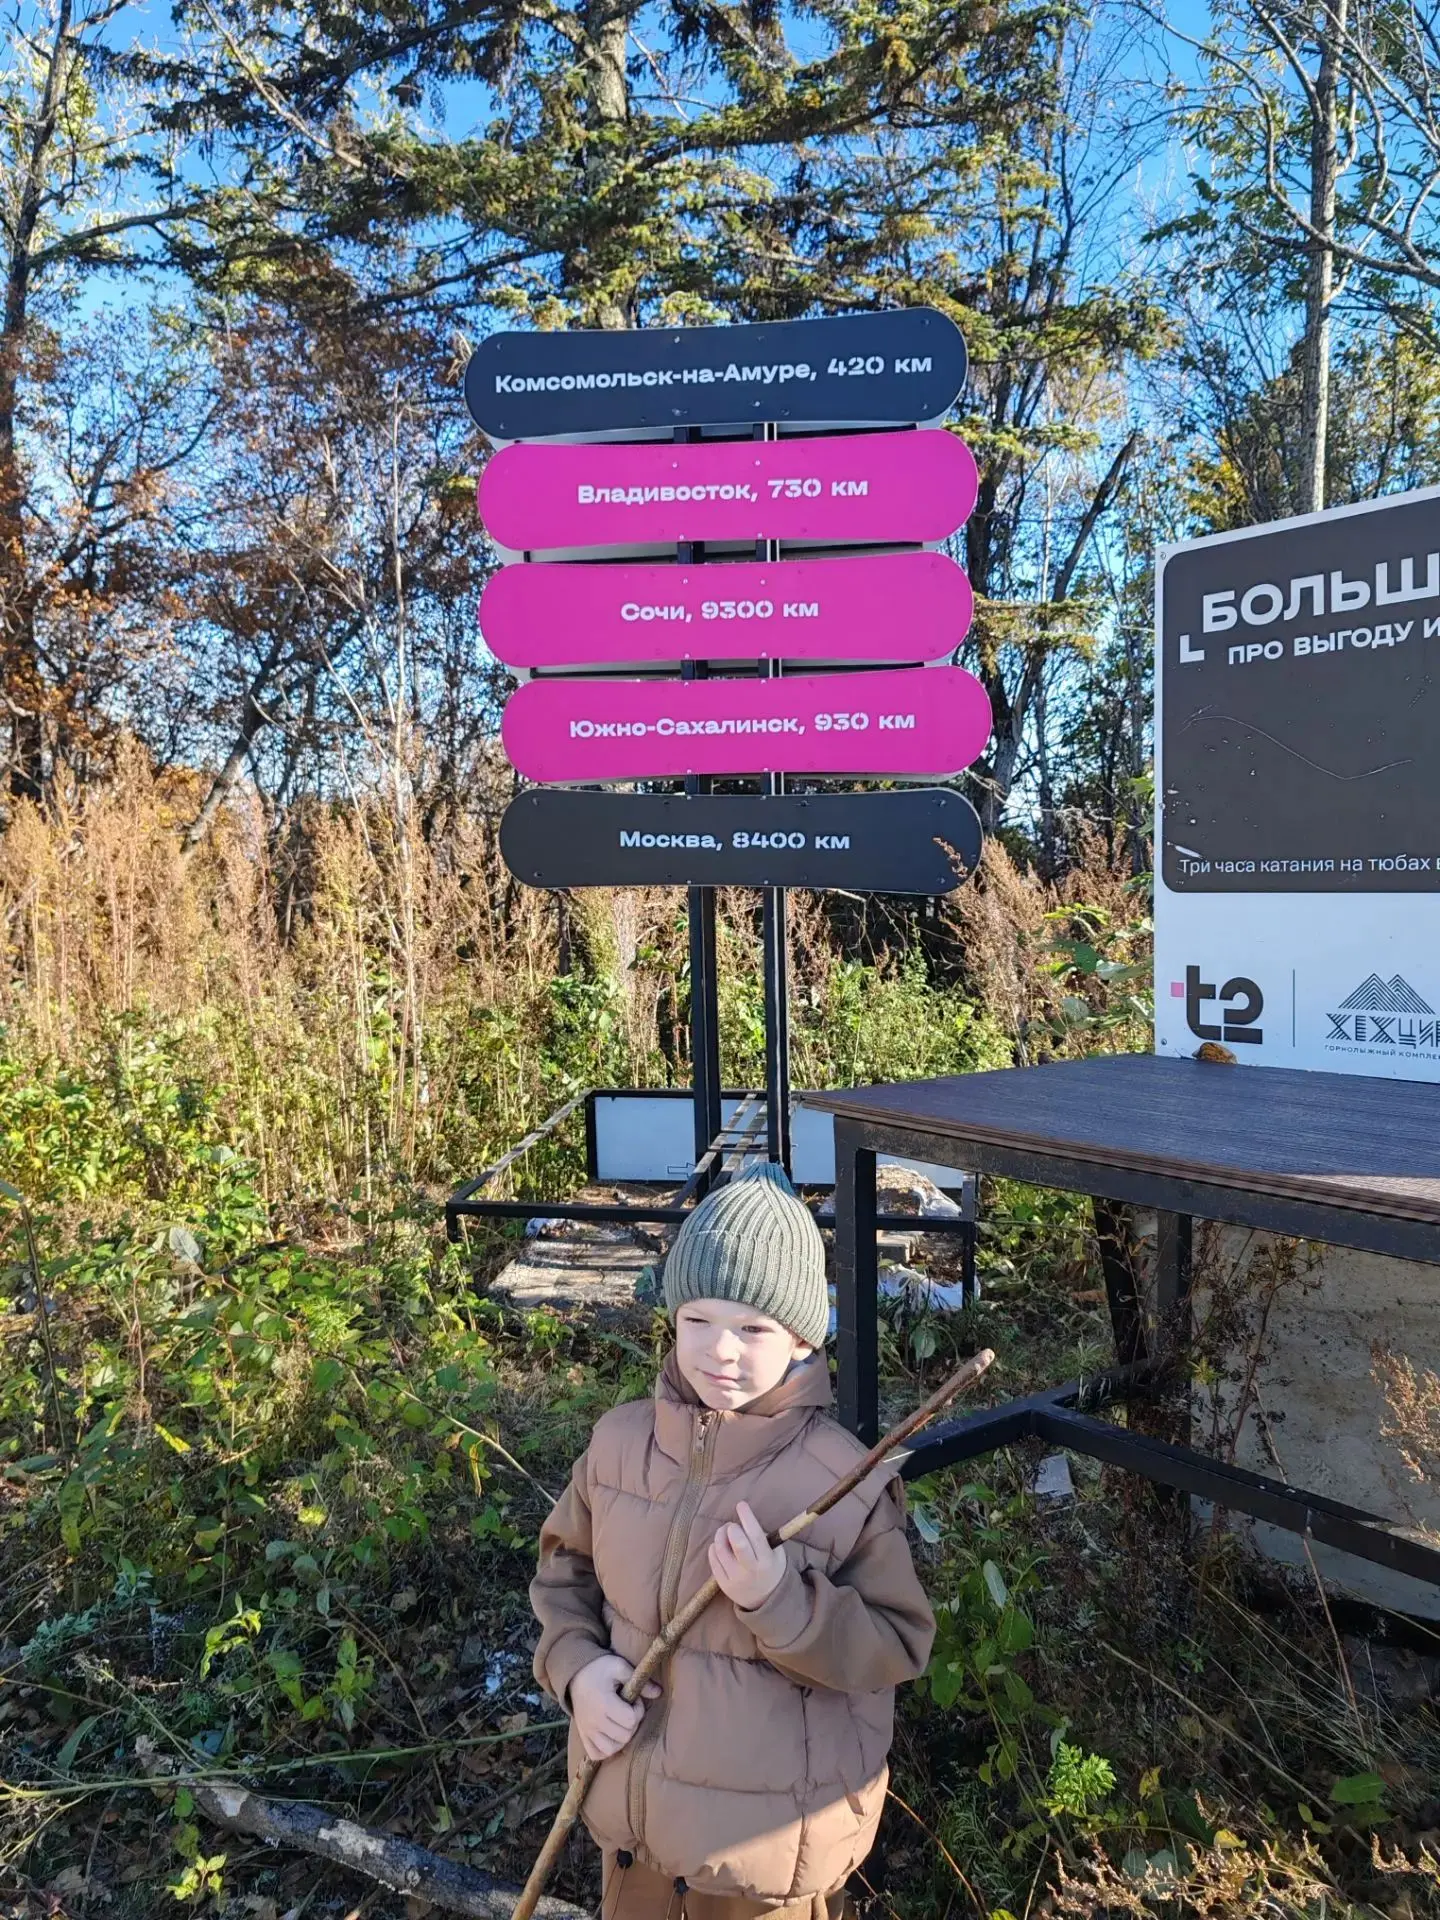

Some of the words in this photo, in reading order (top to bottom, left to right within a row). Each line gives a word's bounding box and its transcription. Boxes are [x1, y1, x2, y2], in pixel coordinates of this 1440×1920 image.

[495, 363, 817, 393] Комсомольск-на-Амуре,
[827, 356, 885, 376] 420
[894, 357, 932, 373] км
[578, 483, 758, 505] Владивосток,
[767, 478, 822, 498] 730
[831, 480, 868, 496] км
[1203, 552, 1440, 633] БОЛЬШ
[620, 603, 693, 622] Сочи,
[701, 600, 774, 619] 9300
[783, 602, 819, 617] км
[1228, 640, 1284, 665] ПРО
[1293, 620, 1415, 657] ВЫГОДУ
[570, 718, 806, 738] Южно-Сахалинск,
[814, 712, 870, 731] 930
[878, 714, 915, 730] км
[620, 830, 723, 851] Москва,
[732, 831, 806, 848] 8400
[815, 835, 850, 849] км
[1179, 859, 1211, 877] Три
[1214, 860, 1256, 873] часа
[1260, 859, 1335, 873] катания
[1340, 858, 1363, 872] на
[1367, 853, 1431, 871] тюбах
[1186, 964, 1264, 1045] t2
[1398, 1051, 1440, 1060] КОМПЛЕ
